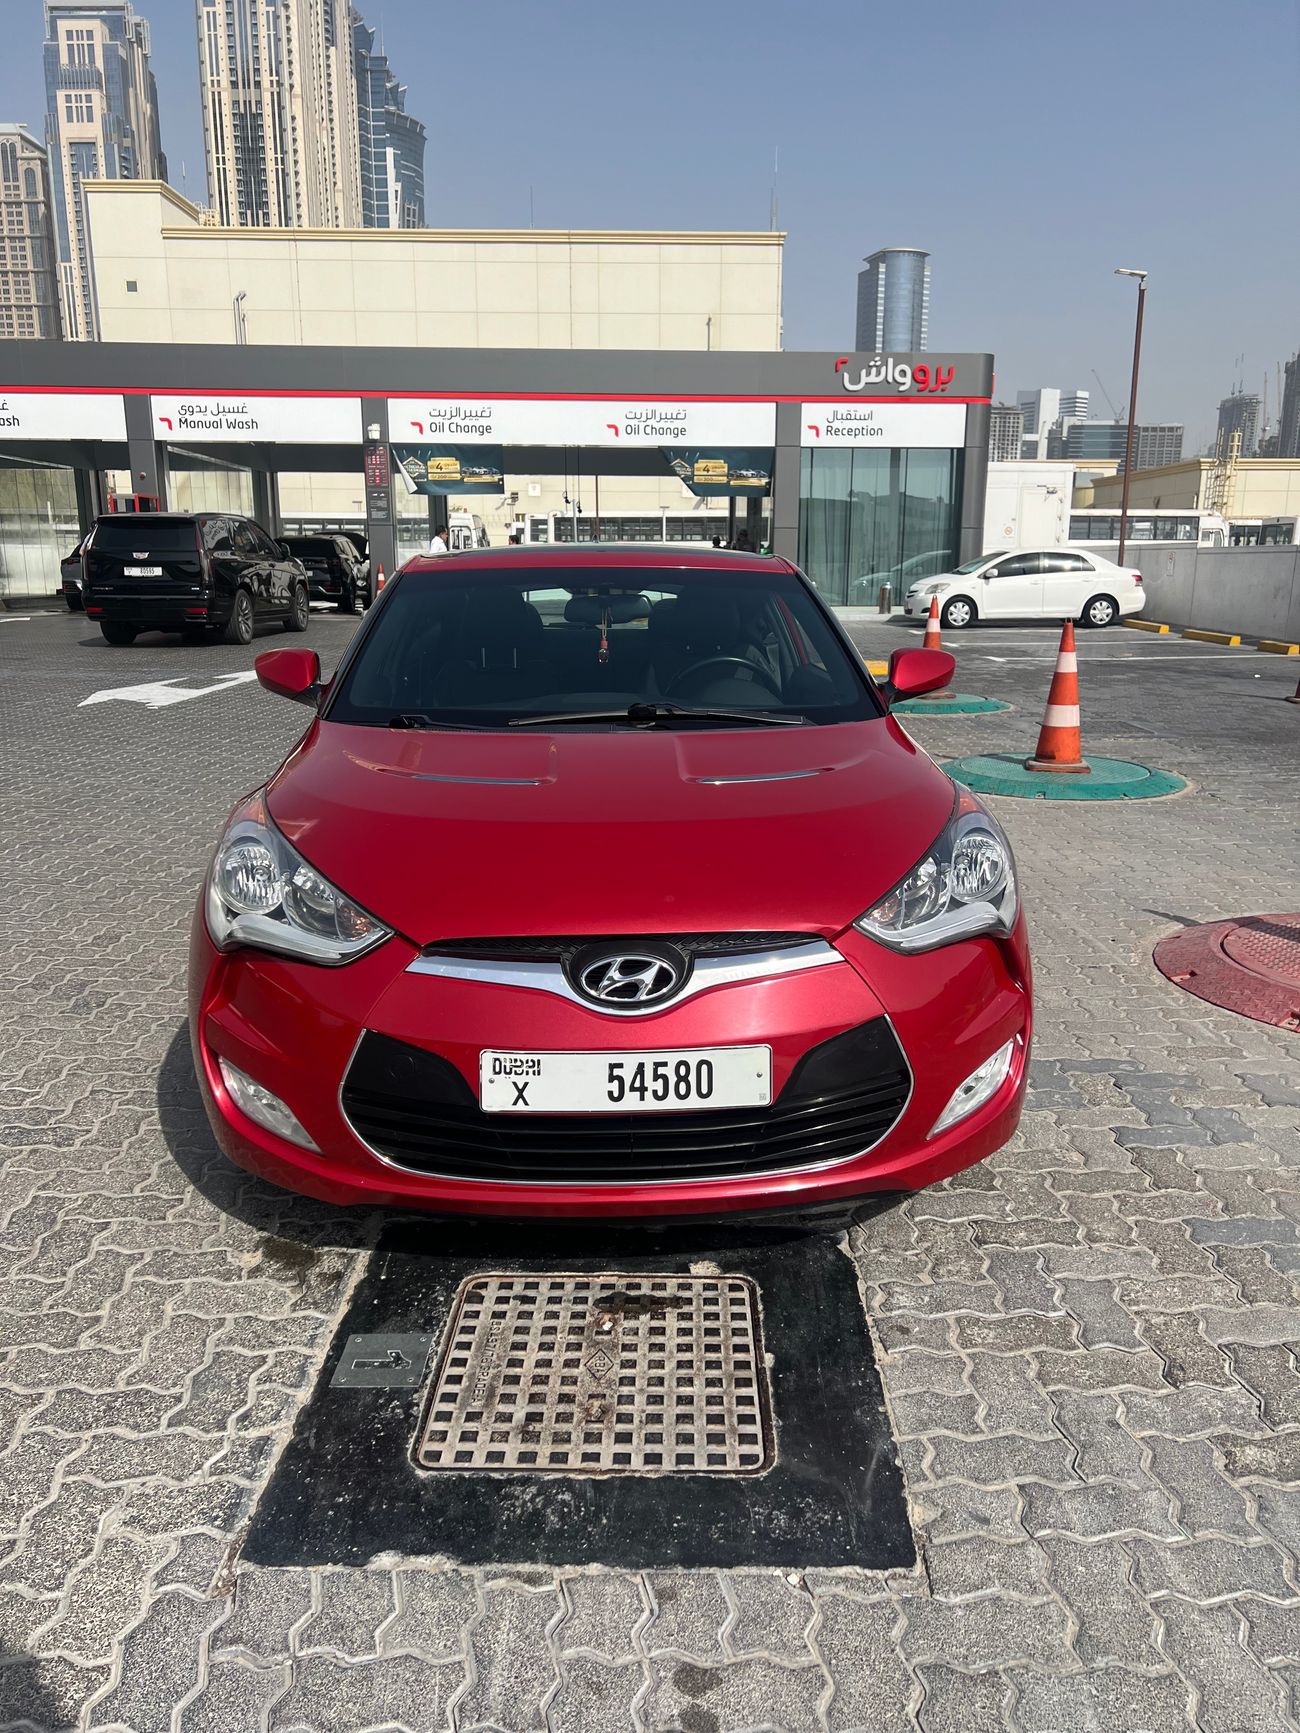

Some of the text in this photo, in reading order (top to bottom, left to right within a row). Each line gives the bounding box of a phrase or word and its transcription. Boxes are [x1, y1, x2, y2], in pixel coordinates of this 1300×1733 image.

[210, 402, 249, 417] غسيل
[826, 409, 873, 424] استقبال
[0, 415, 20, 427] ash
[178, 417, 259, 430] Manual Wash
[429, 421, 492, 436] Oil Change
[625, 424, 687, 439] Oil Change
[825, 425, 883, 439] Reception
[435, 462, 443, 471] 4
[702, 464, 711, 473] 4
[607, 1059, 713, 1102] 54580
[511, 1081, 530, 1106] X
